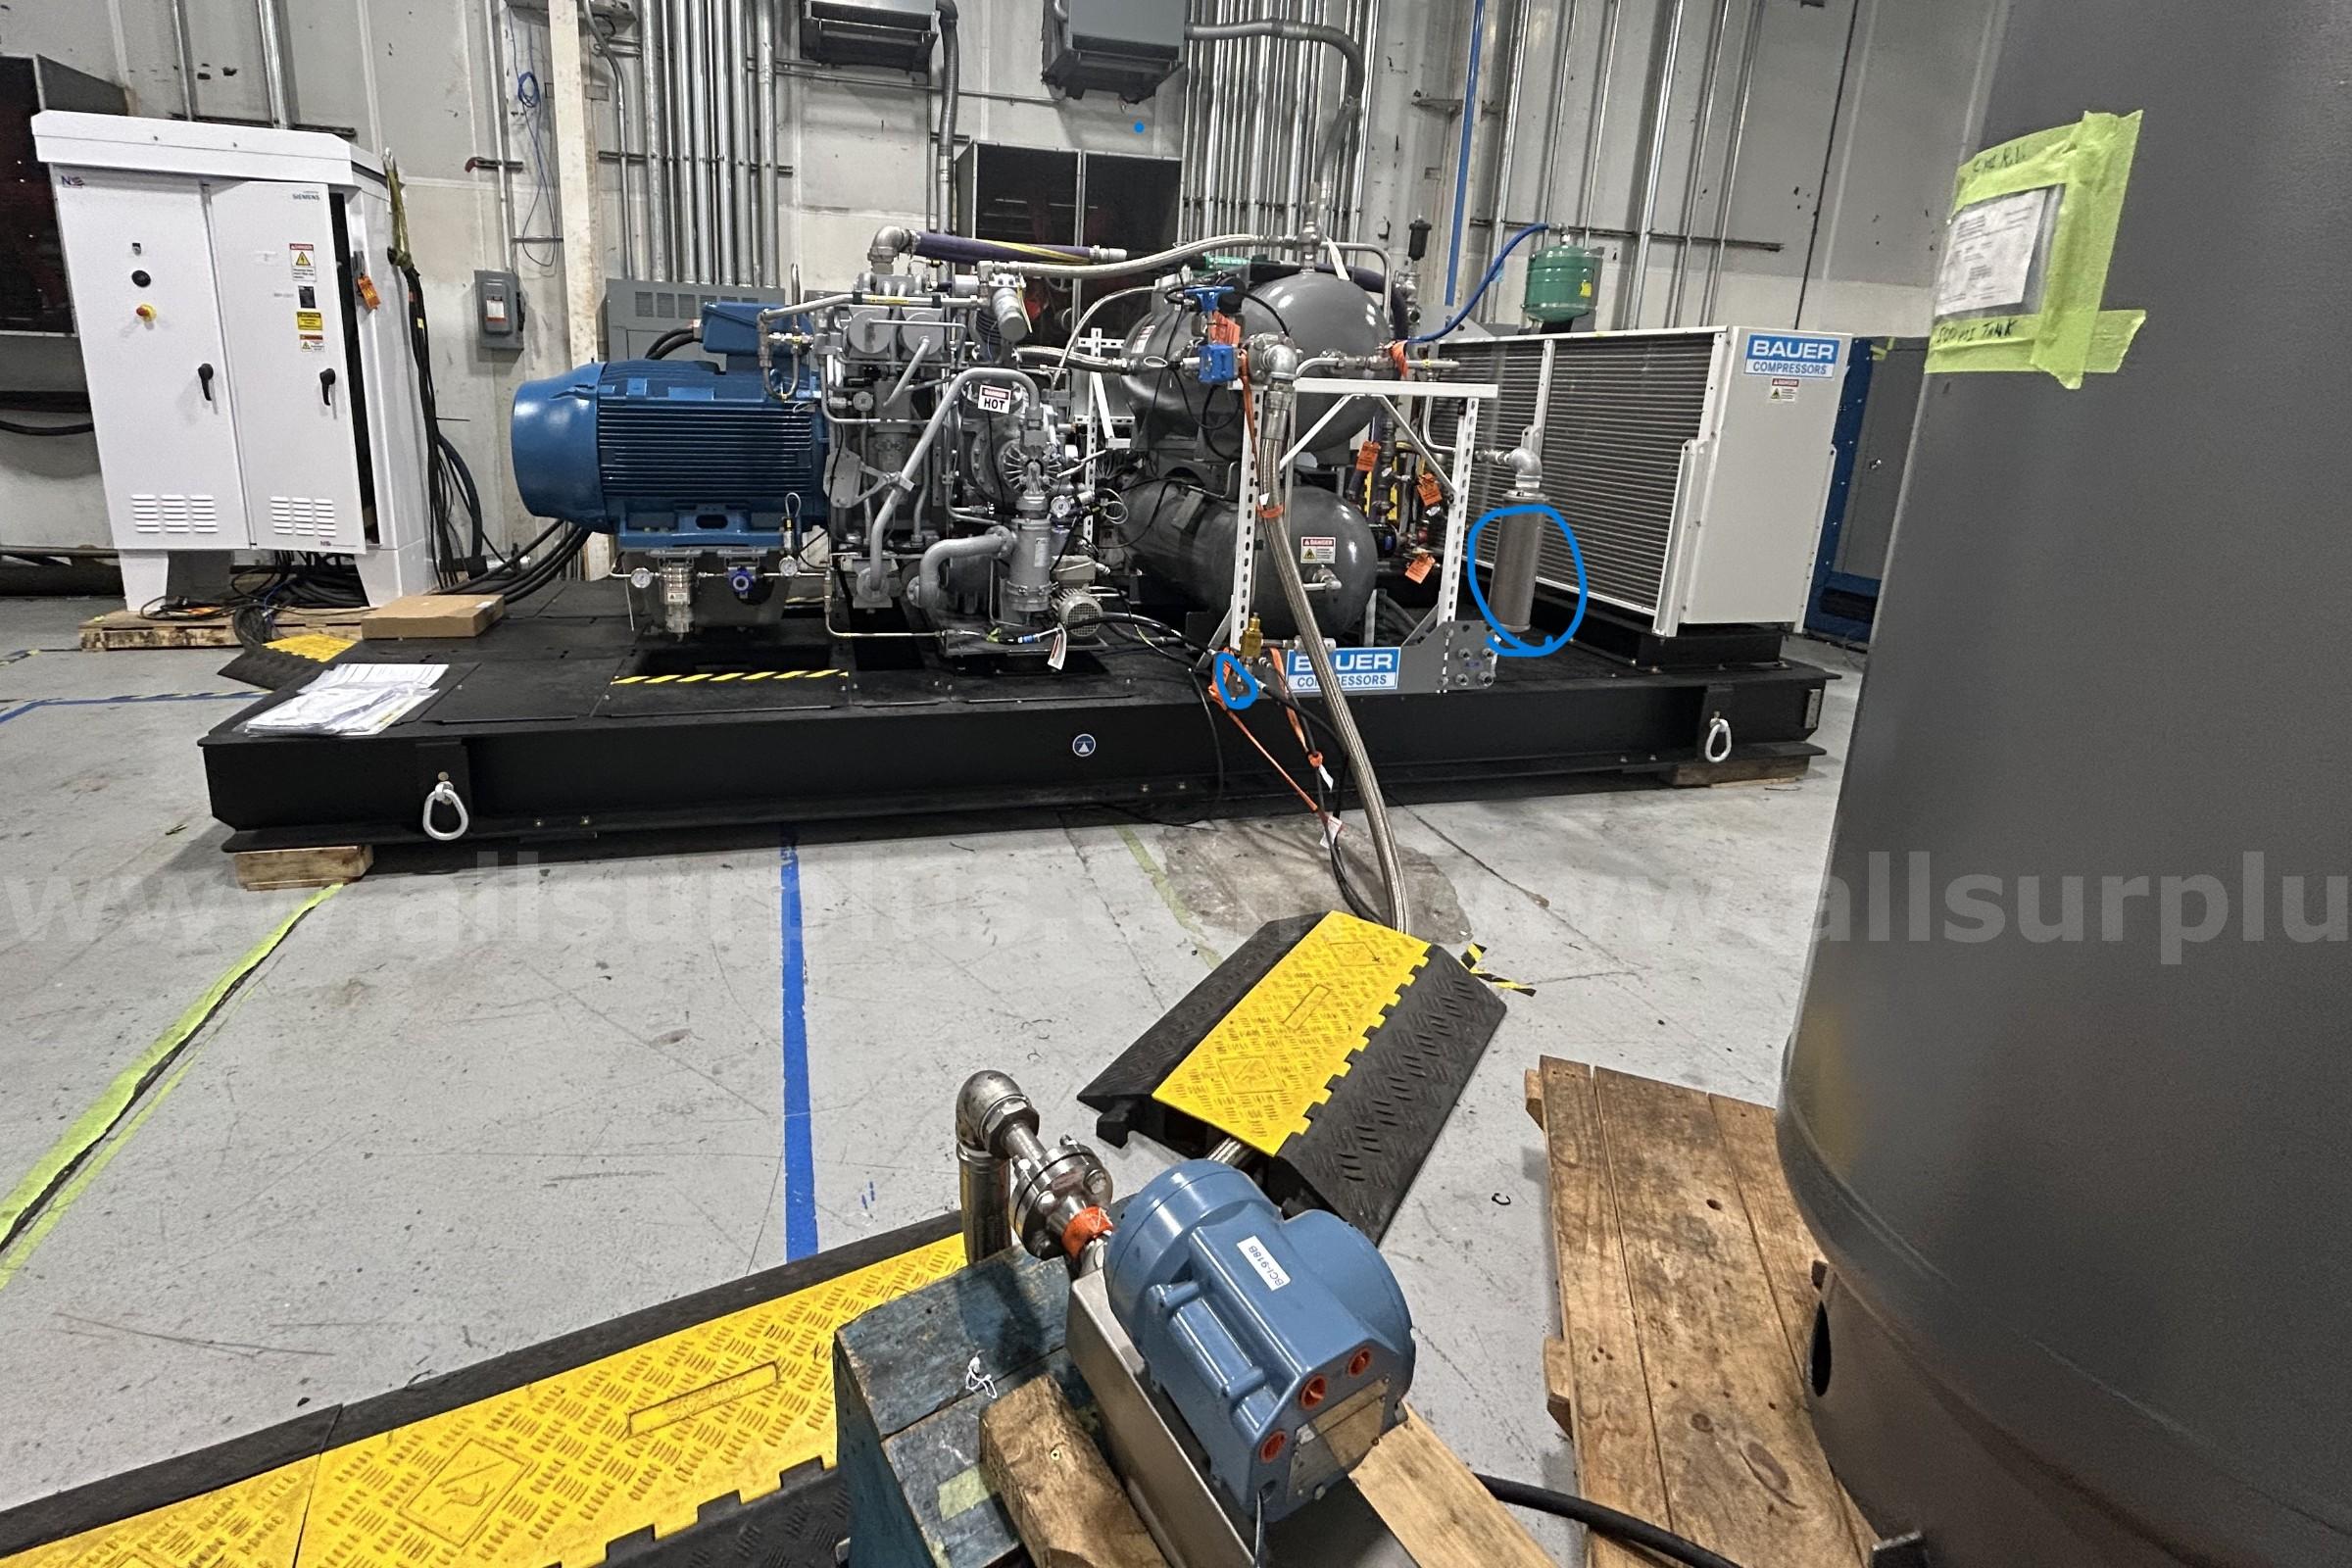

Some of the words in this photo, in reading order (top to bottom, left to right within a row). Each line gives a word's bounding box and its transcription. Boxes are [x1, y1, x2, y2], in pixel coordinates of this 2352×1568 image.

[1751, 339, 1836, 361] BAUER
[1752, 361, 1827, 375] COMPRESSORS
[984, 397, 1005, 411] HOT
[1294, 653, 1394, 672] BUER
[1297, 674, 1387, 688] COESSORS
